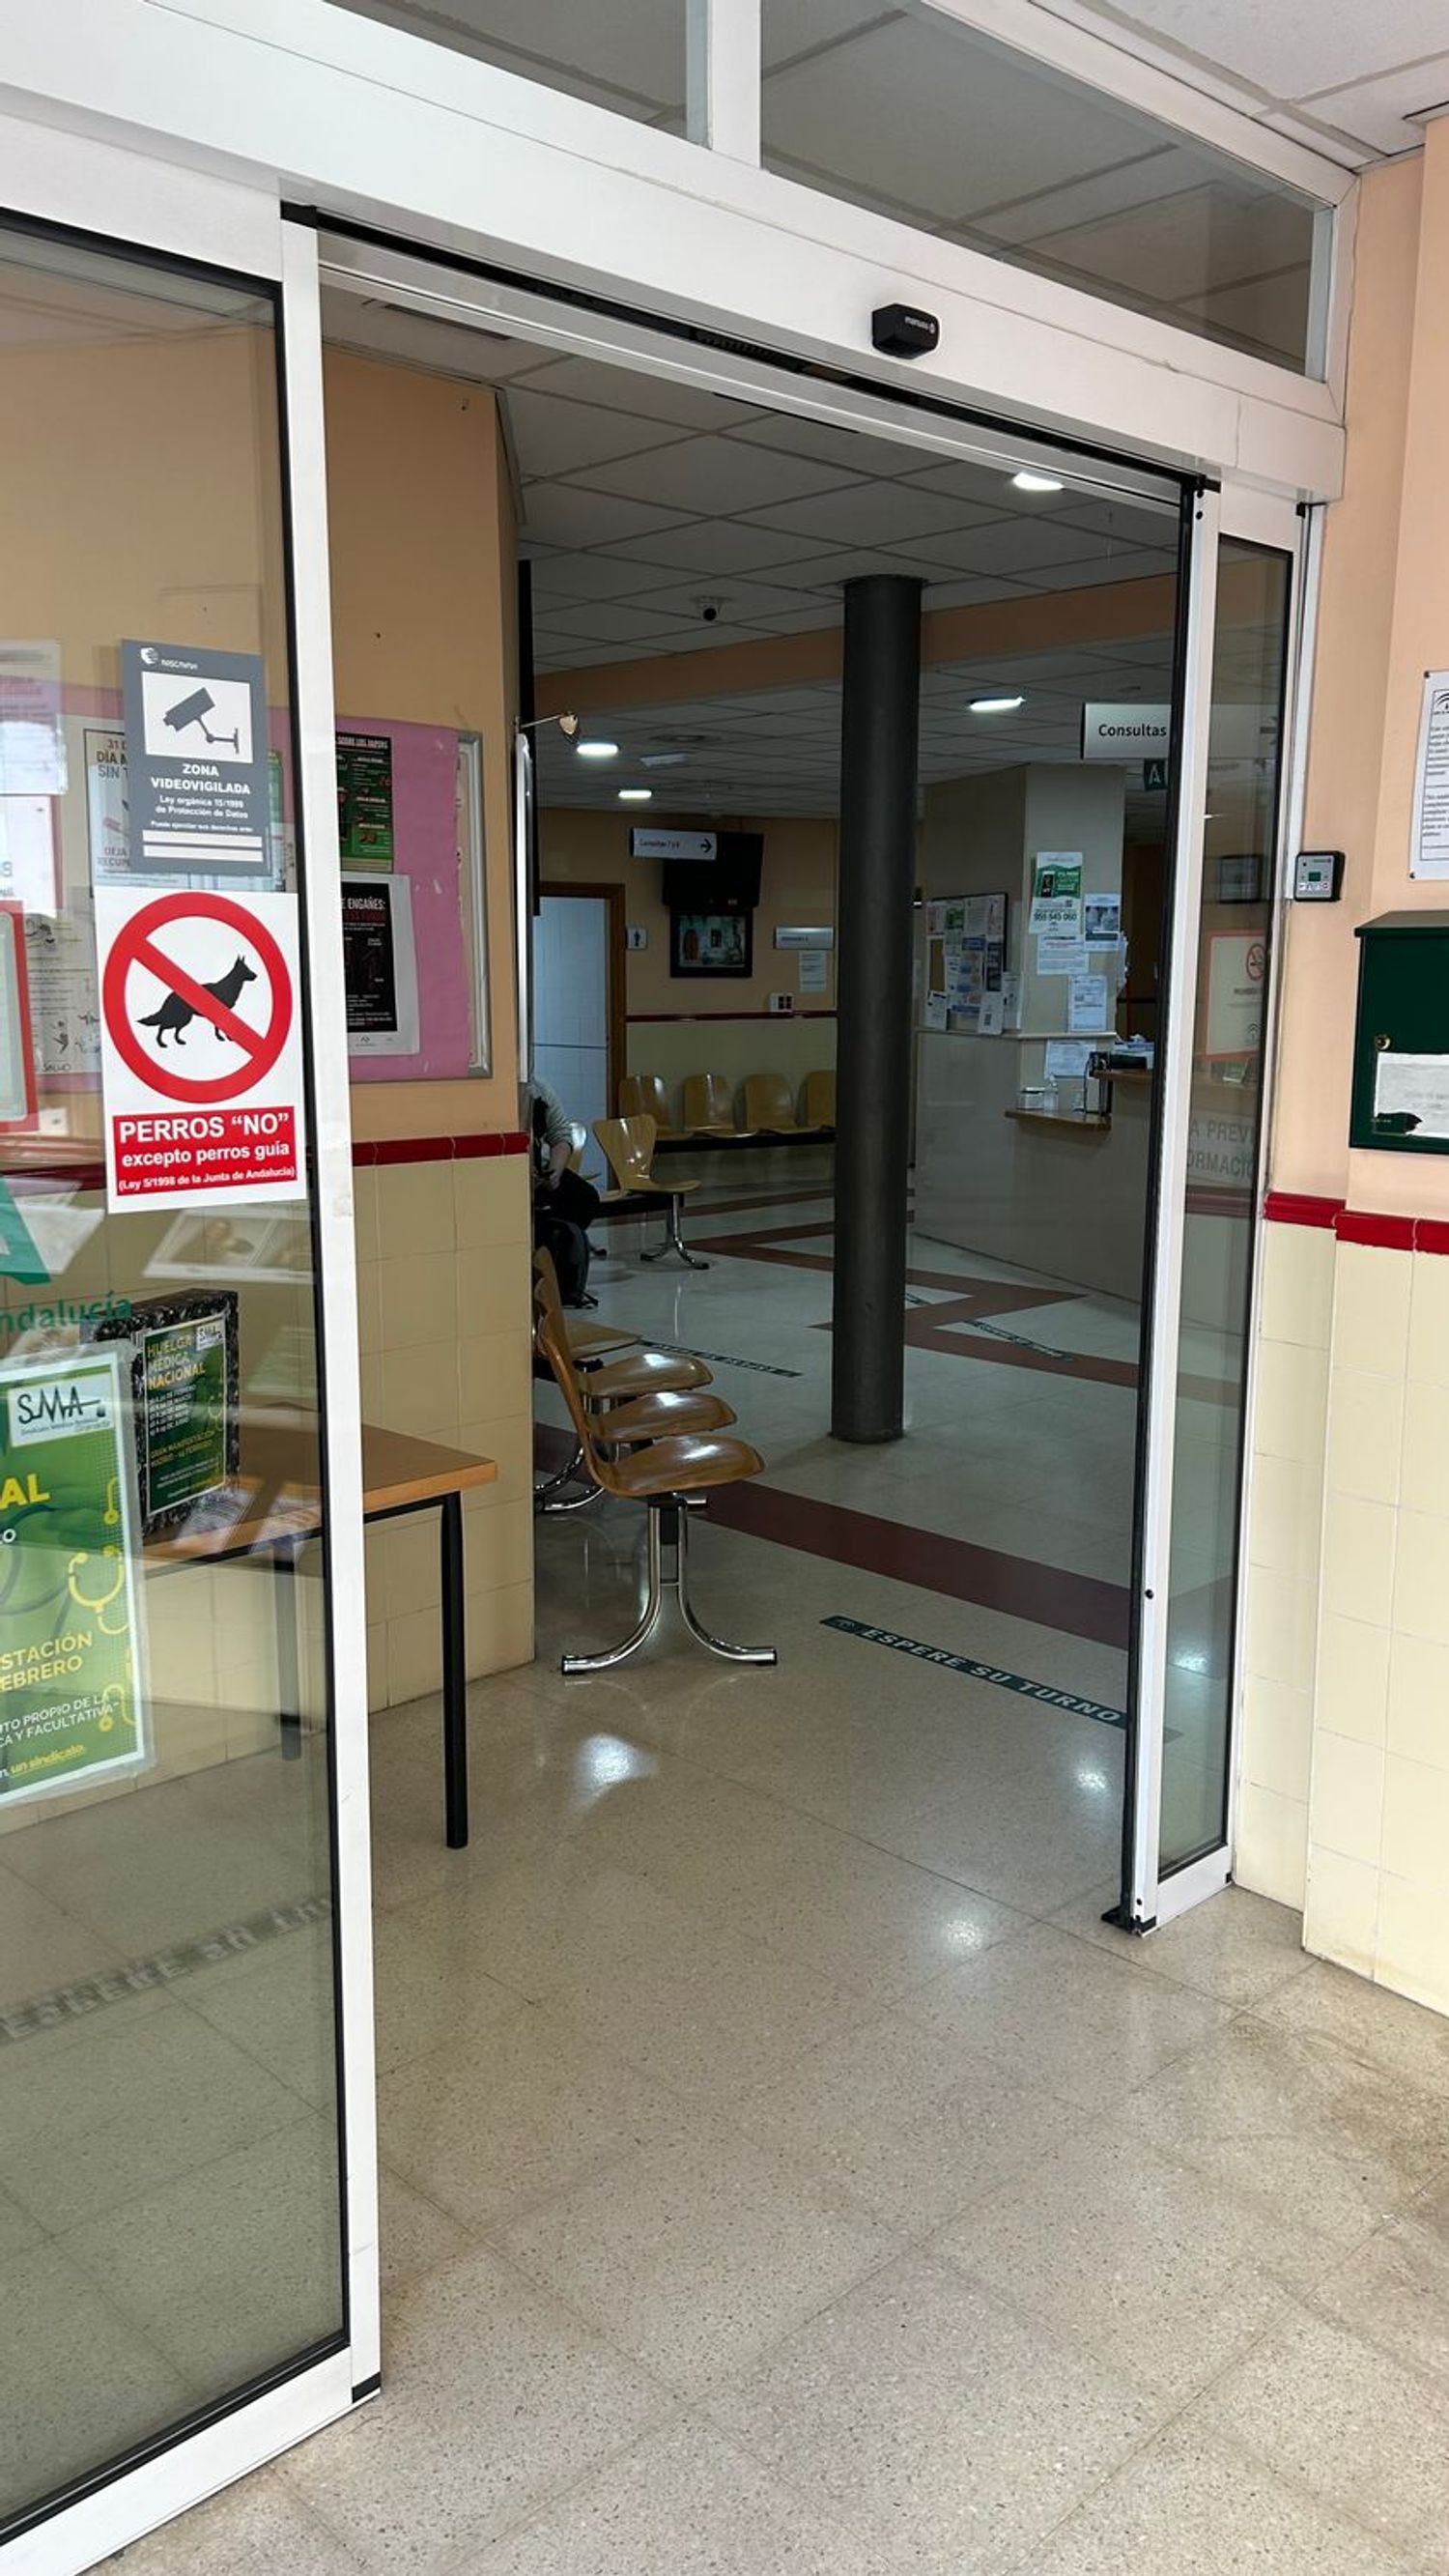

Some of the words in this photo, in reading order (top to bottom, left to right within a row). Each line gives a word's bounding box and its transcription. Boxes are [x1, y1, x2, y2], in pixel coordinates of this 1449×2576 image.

[1098, 723, 1167, 738] Consultas
[98, 766, 120, 779] SIN
[182, 763, 219, 777] ZONA
[151, 777, 251, 794] VIDEOVIGILADA
[159, 795, 175, 806] Ley
[155, 805, 166, 814] de
[213, 809, 223, 817] de
[225, 809, 248, 819] Datos
[119, 1116, 225, 1144] PERROS
[122, 1149, 192, 1168] excepto
[195, 1145, 250, 1165] perros
[254, 1140, 290, 1160] guía
[118, 1178, 141, 1192] (Ley
[177, 1175, 190, 1185] de
[191, 1173, 202, 1184] la
[203, 1171, 231, 1184] Junta
[232, 1170, 244, 1181] de
[148, 1362, 206, 1389] NACIONAL
[17, 1385, 100, 1424] SMA
[0, 1655, 83, 1692] EBRERO
[863, 1627, 967, 1669] ESPERE
[970, 1665, 1010, 1684] SU
[1017, 1680, 1121, 1723] TURNO
[23, 1703, 71, 1726] PROPIO
[73, 1698, 92, 1710] DE
[94, 1694, 109, 1705] LA
[15, 1730, 25, 1741] Y
[11, 1761, 28, 1774] un
